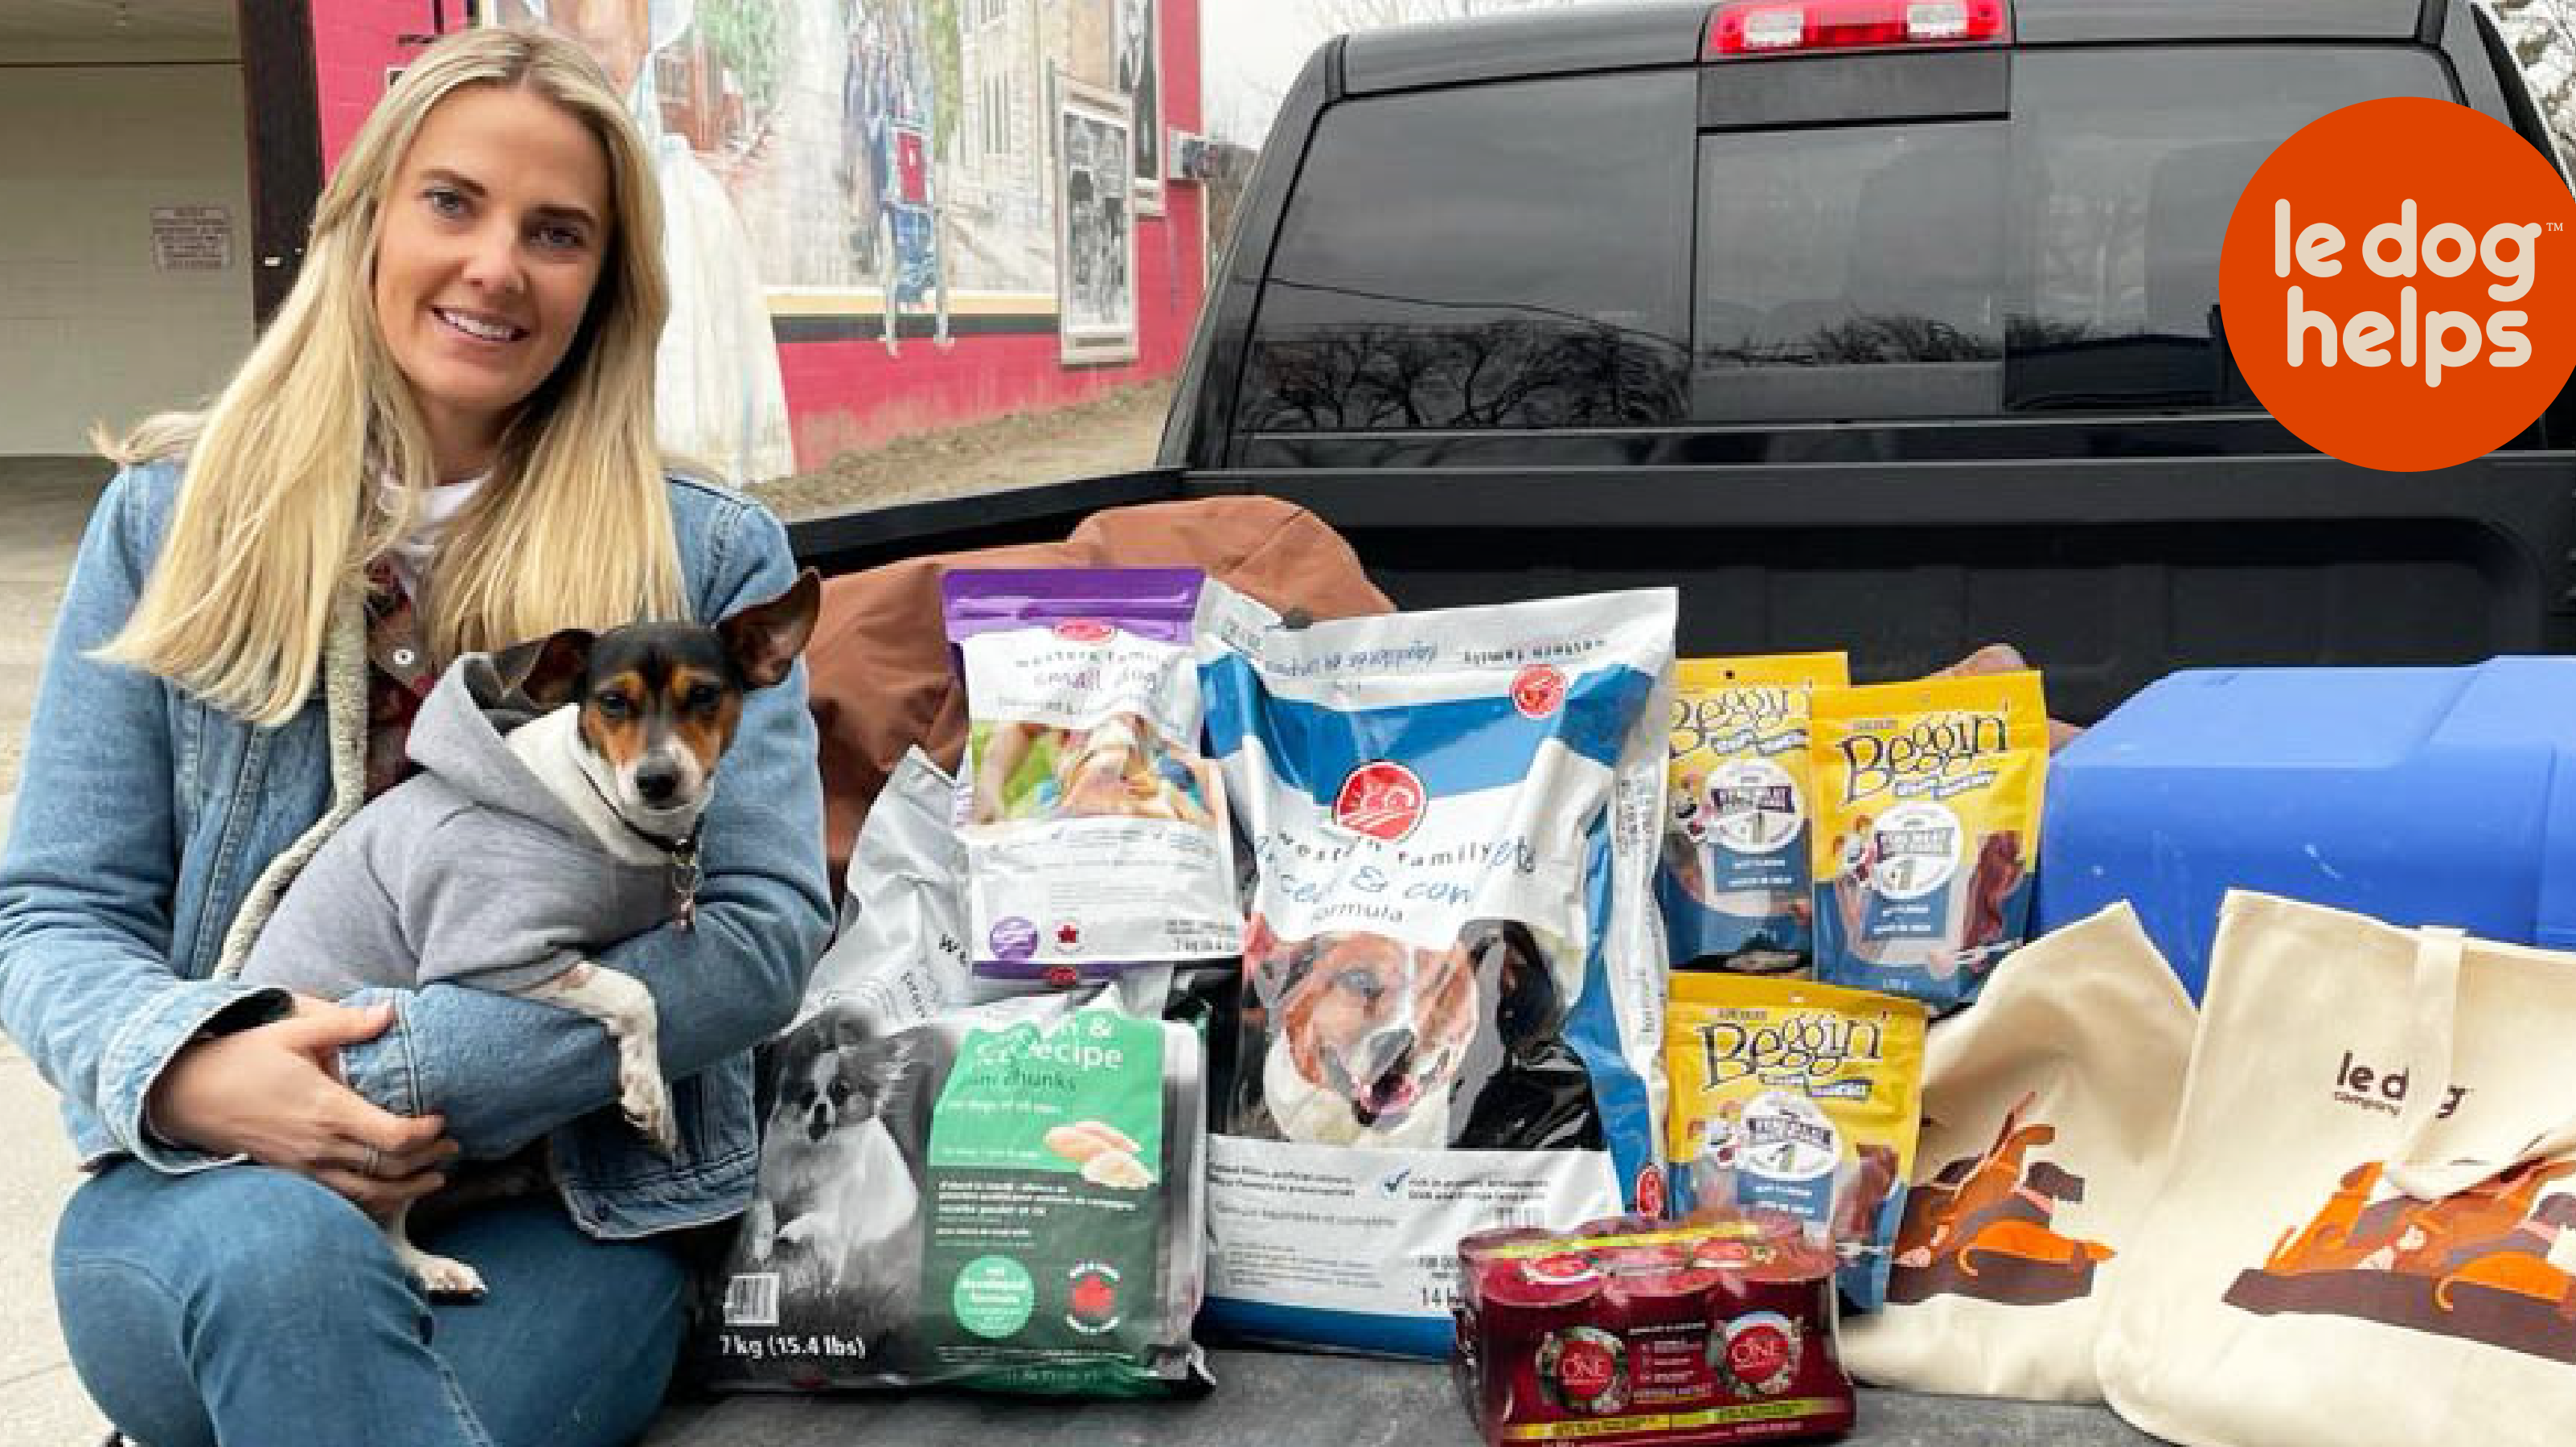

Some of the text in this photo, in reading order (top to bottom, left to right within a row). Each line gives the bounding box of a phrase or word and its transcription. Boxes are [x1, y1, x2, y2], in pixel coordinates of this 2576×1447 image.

[1278, 832, 1381, 862] westn
[2336, 1049, 2374, 1092] le
[719, 1334, 866, 1359] 7 kg (15.4 lbs)
